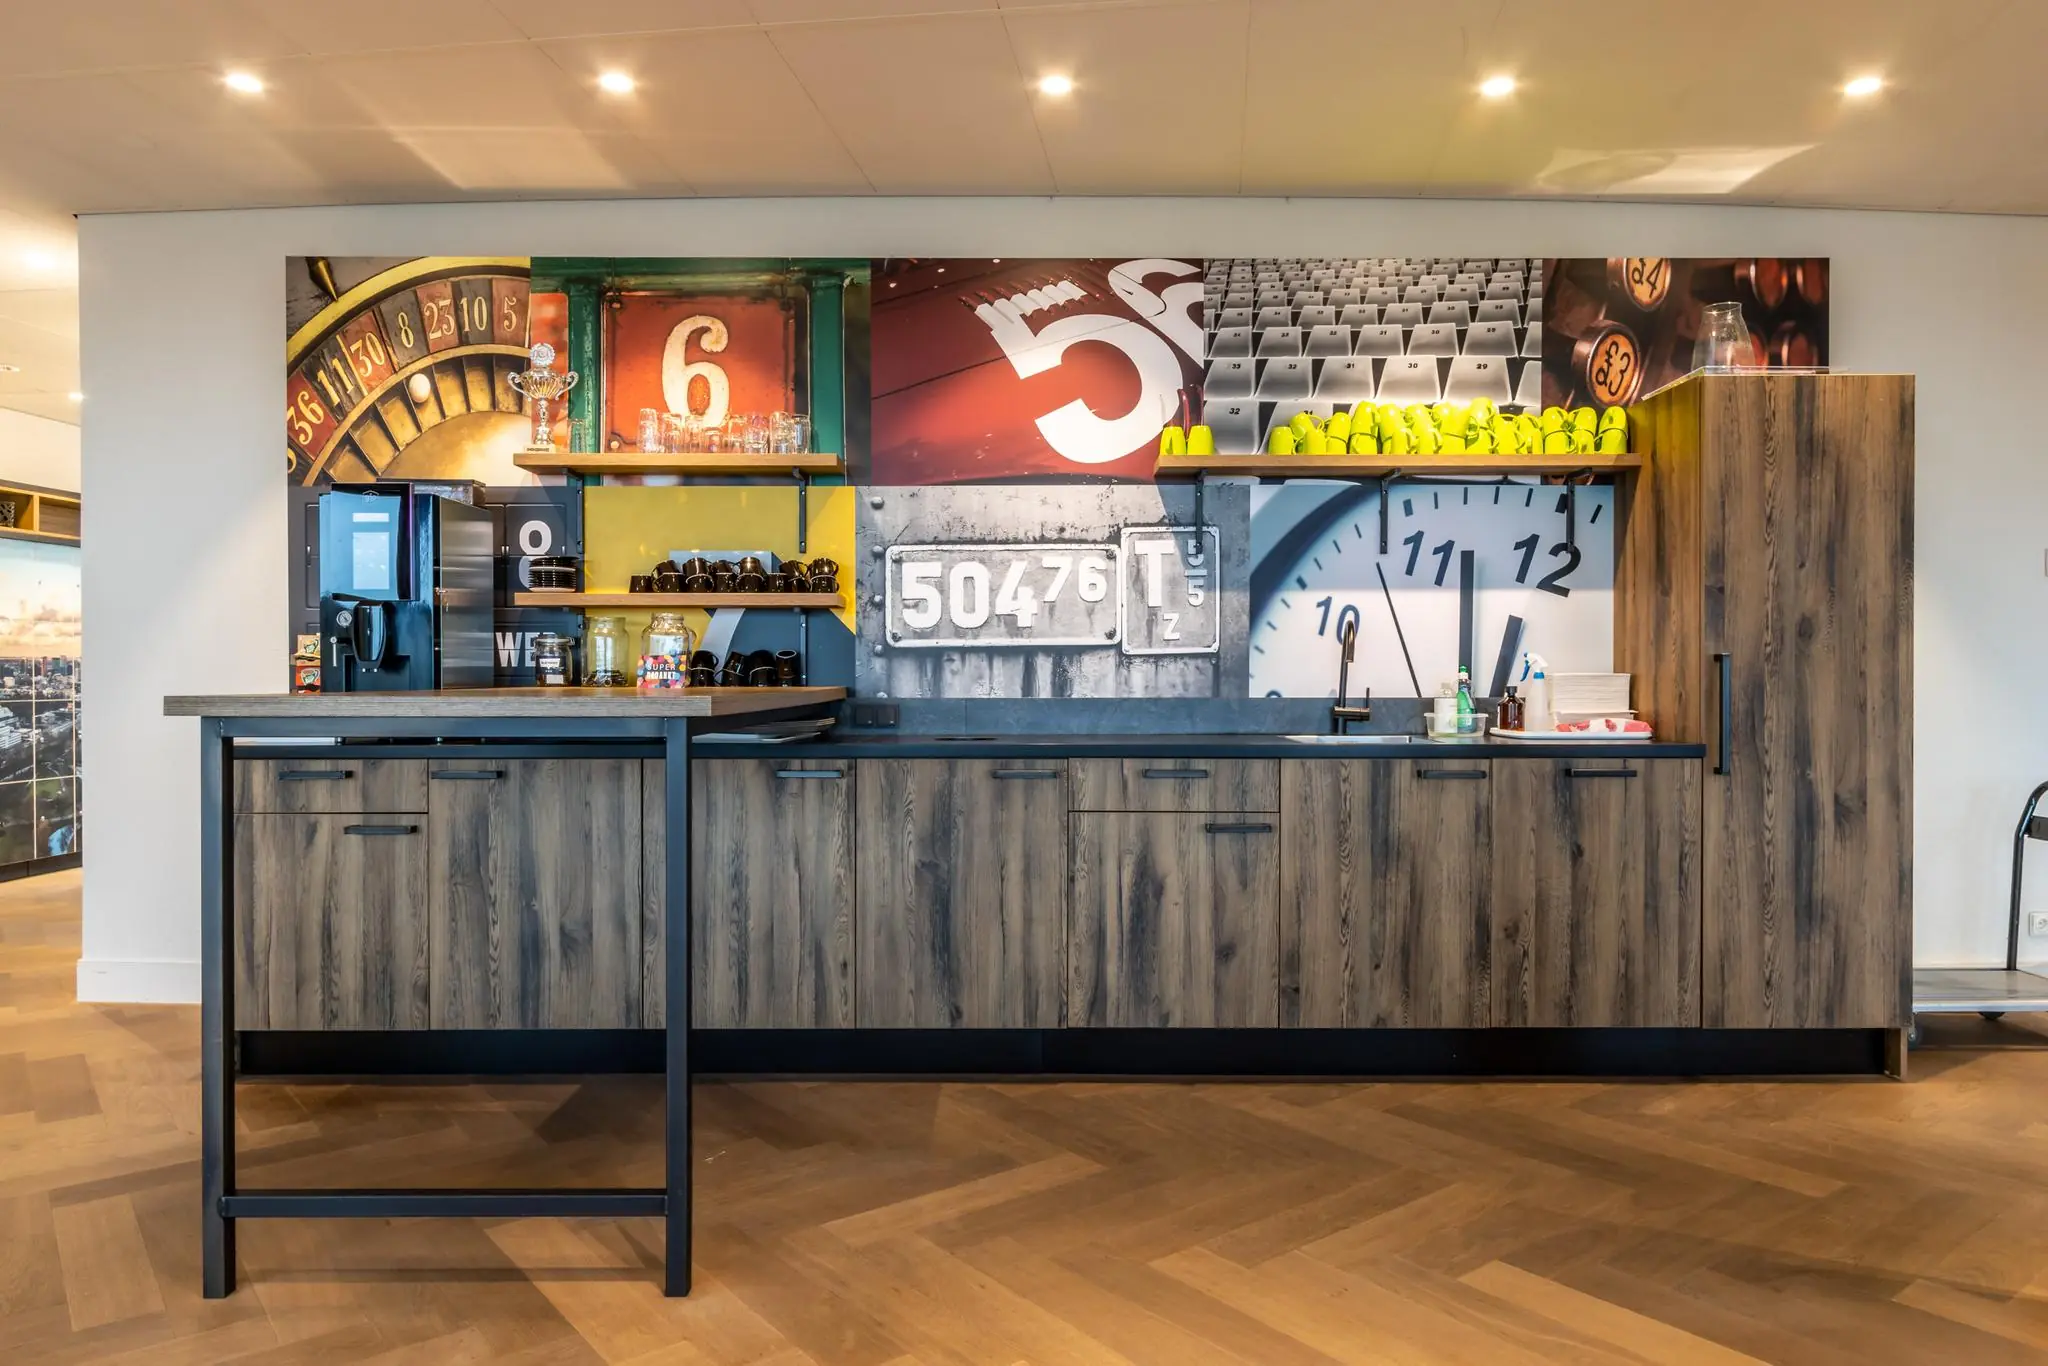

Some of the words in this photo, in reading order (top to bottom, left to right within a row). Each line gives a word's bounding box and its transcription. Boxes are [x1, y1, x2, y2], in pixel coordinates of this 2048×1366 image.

[398, 311, 414, 348] 8
[423, 298, 455, 340] 23
[460, 296, 488, 332] 10
[503, 296, 517, 332] 5
[350, 332, 386, 378] 30
[661, 314, 730, 428] 6
[1345, 362, 1355, 370] 31
[317, 357, 354, 407] 11
[287, 391, 325, 446] 36
[1228, 407, 1241, 415] 32
[1134, 540, 1175, 608] T
[1402, 529, 1456, 588] 11
[1513, 533, 1582, 598] 12
[1315, 595, 1361, 646] 10
[495, 631, 556, 668] WE
[647, 663, 676, 671] SUPER
